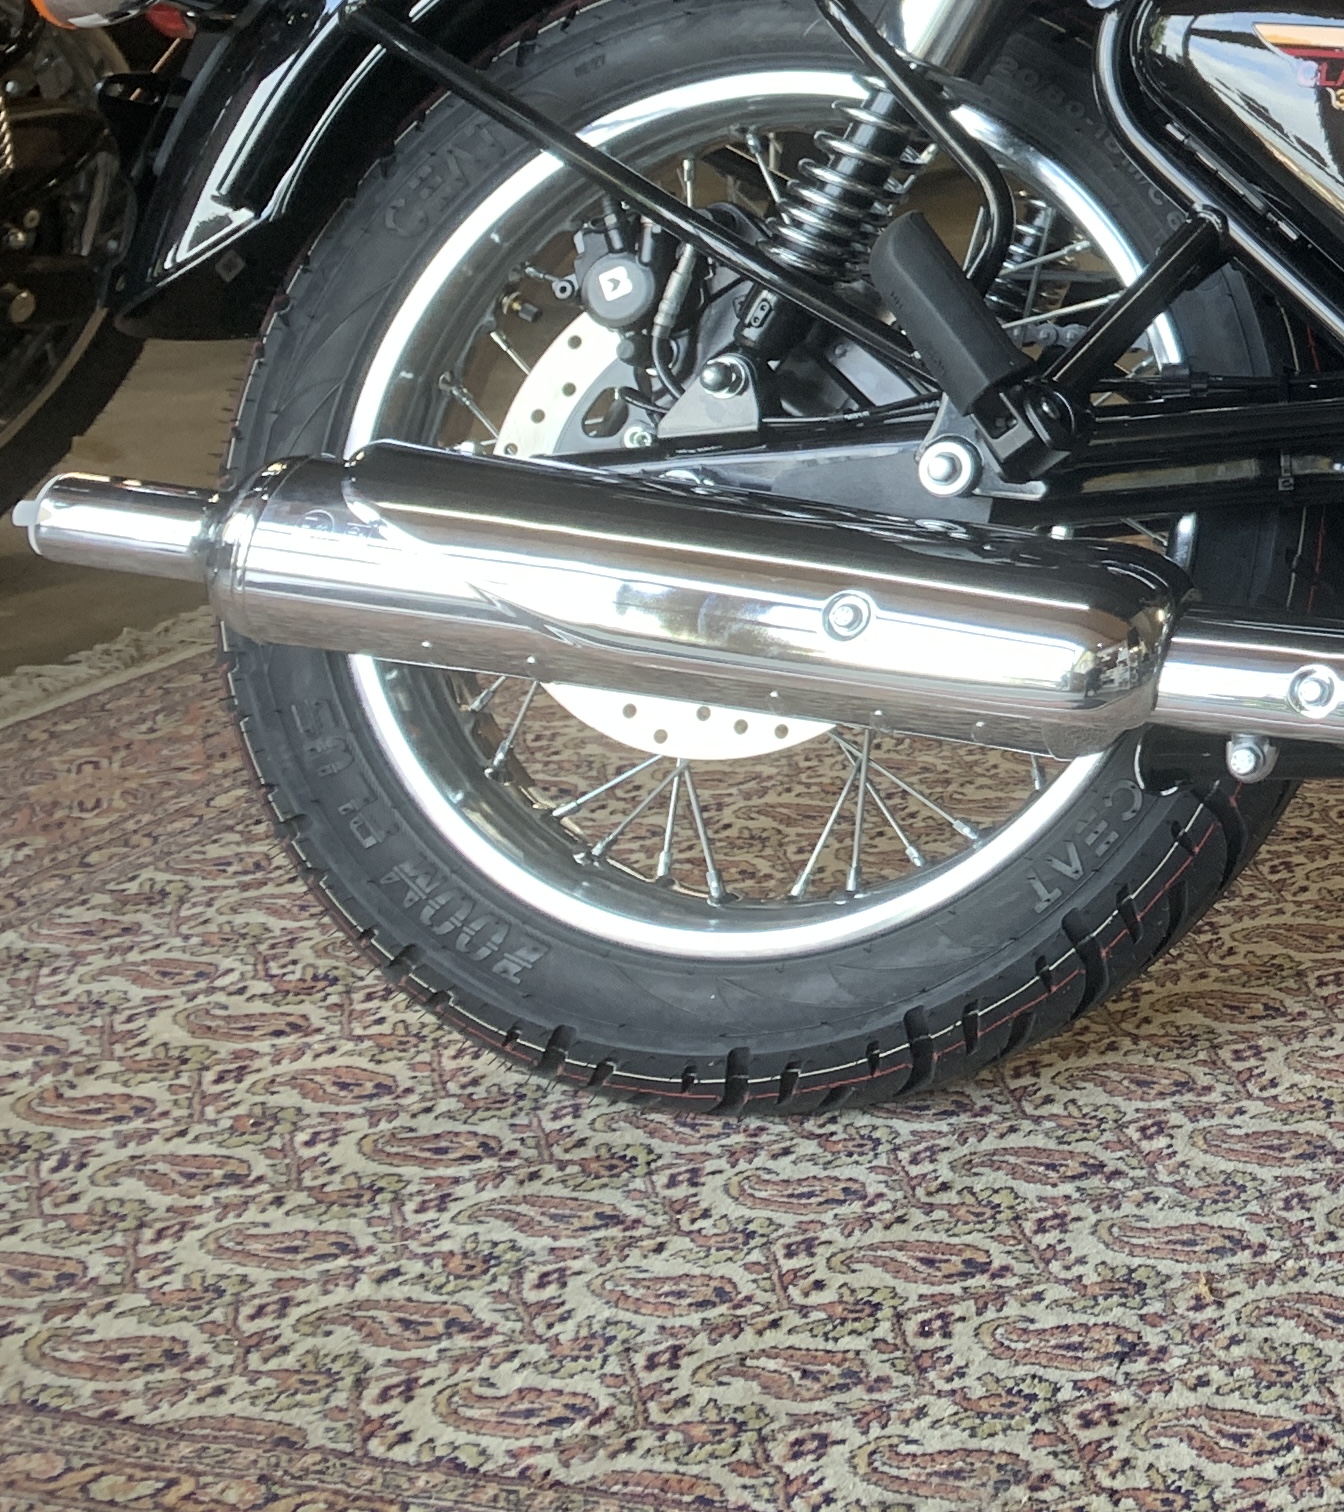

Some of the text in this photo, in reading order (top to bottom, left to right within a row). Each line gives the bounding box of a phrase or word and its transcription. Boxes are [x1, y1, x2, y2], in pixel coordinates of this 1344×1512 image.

[380, 112, 507, 238] CEAT
[287, 692, 402, 852] PLUS
[1028, 776, 1142, 915] CEAT
[380, 852, 550, 986] ZOOM
